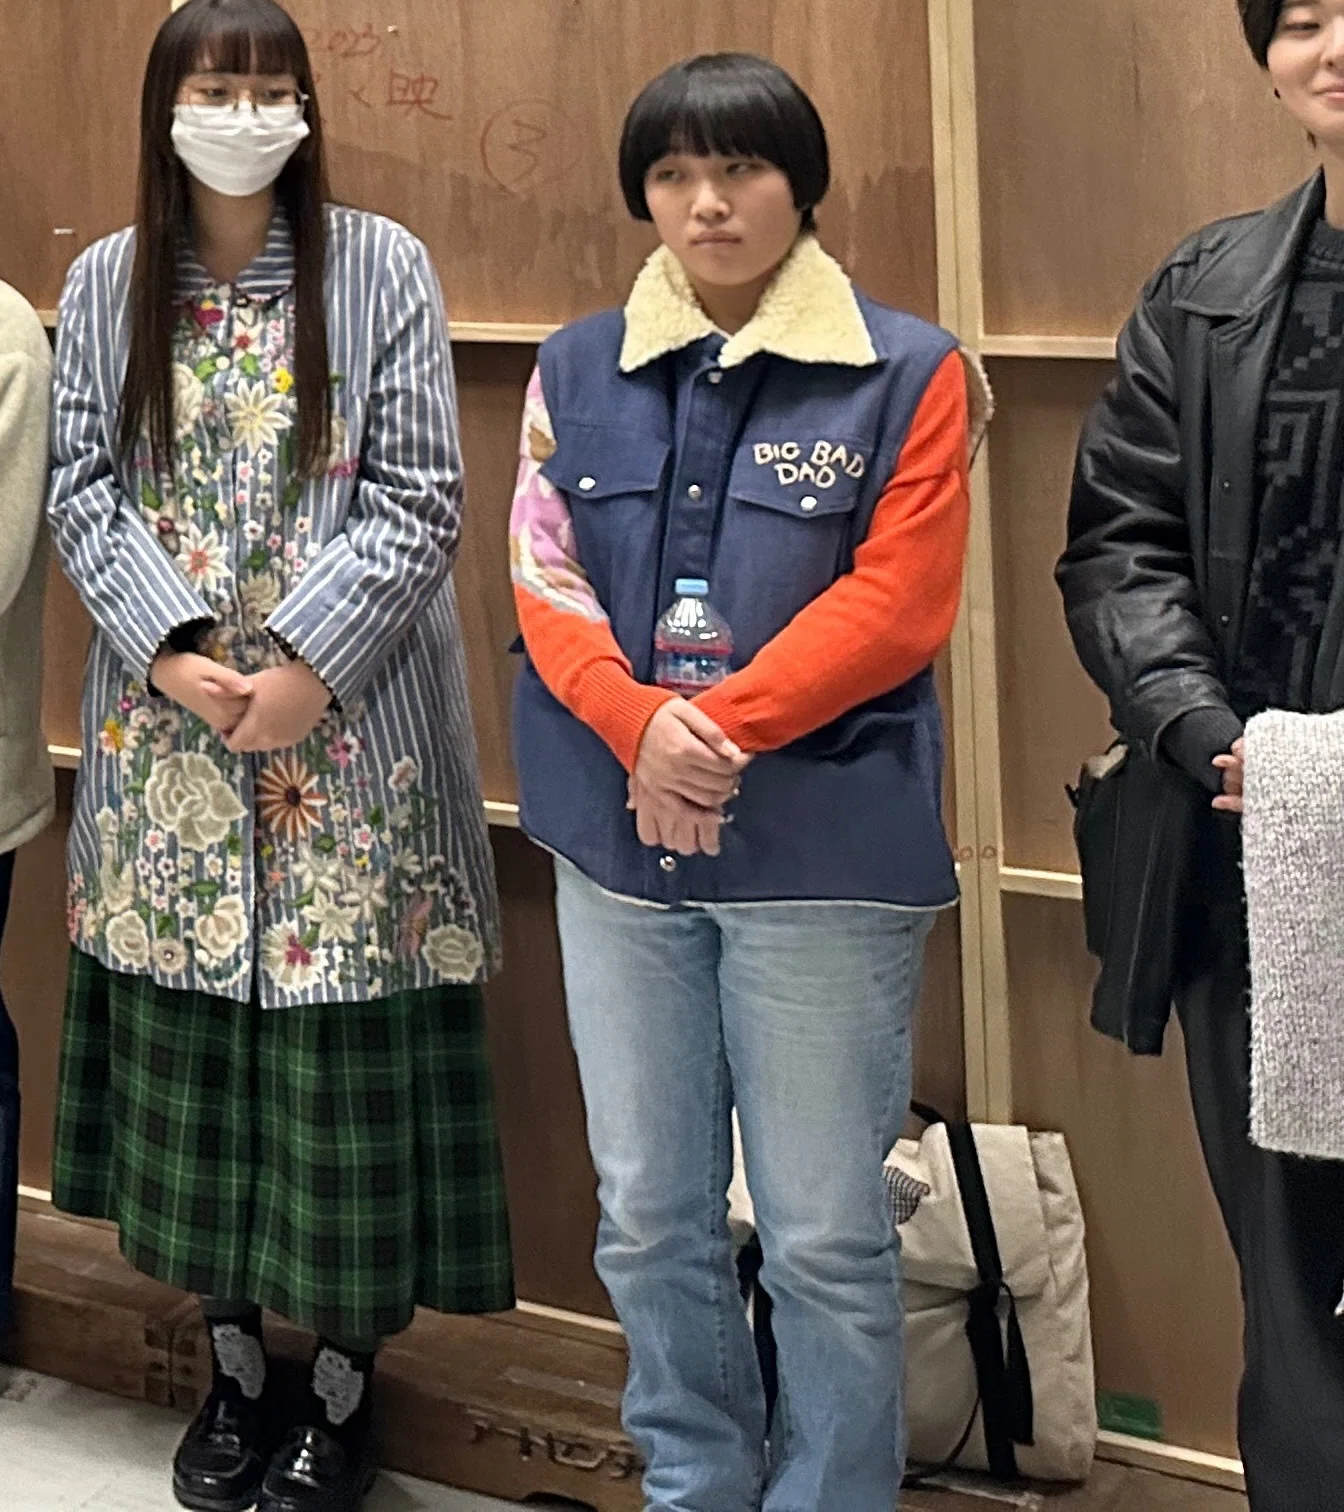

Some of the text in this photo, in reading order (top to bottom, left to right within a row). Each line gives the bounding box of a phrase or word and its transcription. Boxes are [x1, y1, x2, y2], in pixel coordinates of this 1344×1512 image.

[753, 440, 866, 479] BIG BAD
[773, 461, 837, 489] DAD
